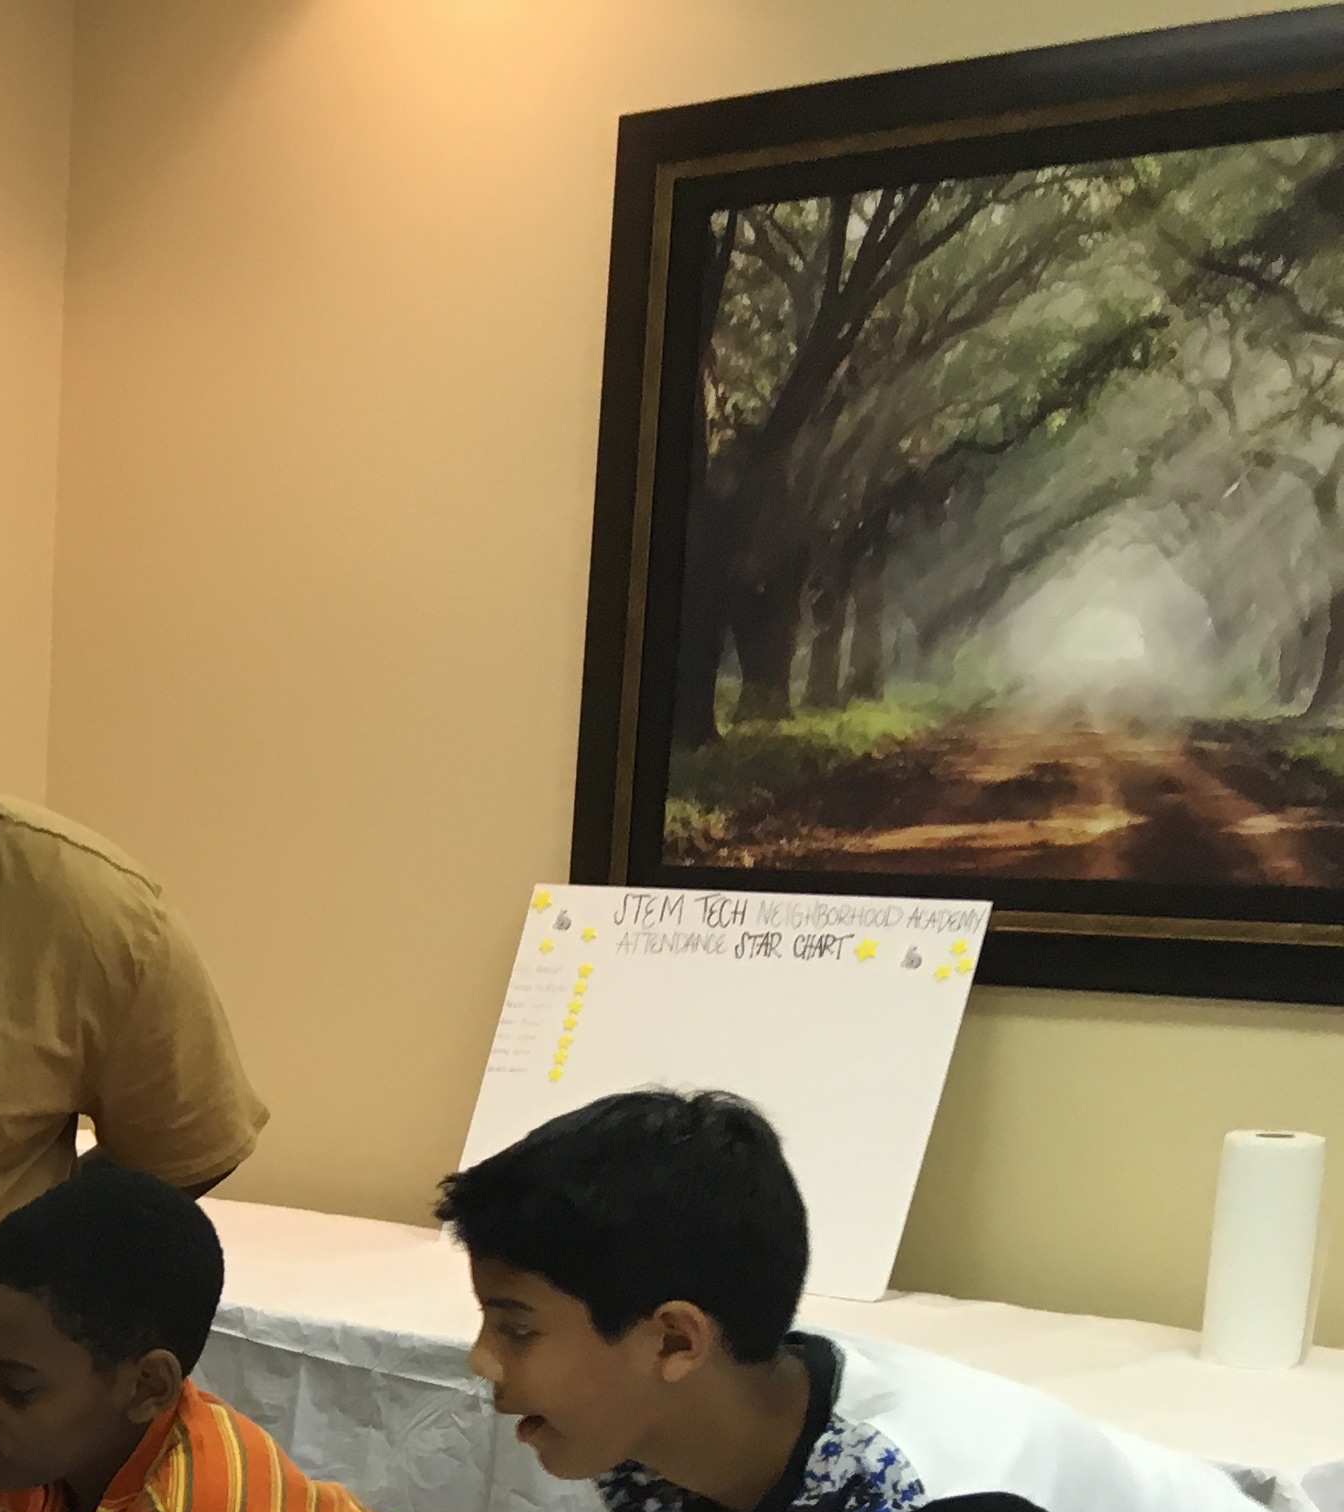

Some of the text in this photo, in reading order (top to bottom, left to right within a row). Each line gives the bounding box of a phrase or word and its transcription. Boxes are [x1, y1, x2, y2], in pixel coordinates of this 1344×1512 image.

[614, 893, 984, 935] STEM TECH NEIGHBORHOOD ACADEMY
[616, 929, 857, 961] ATTENDANCE STAR CHART
